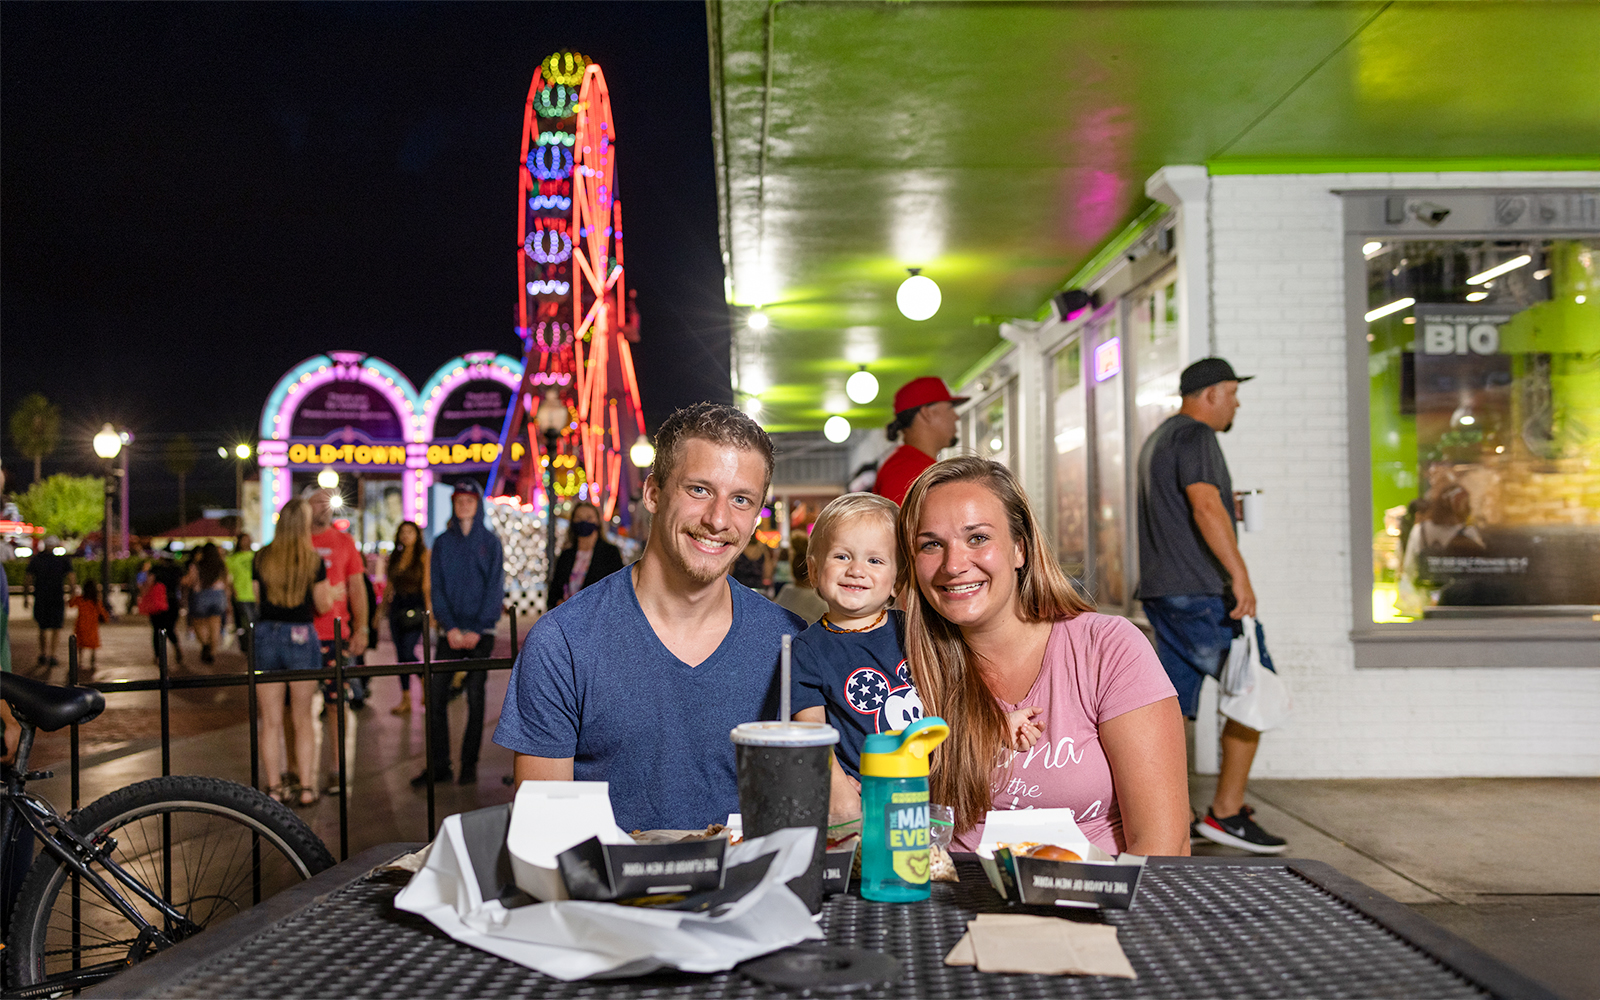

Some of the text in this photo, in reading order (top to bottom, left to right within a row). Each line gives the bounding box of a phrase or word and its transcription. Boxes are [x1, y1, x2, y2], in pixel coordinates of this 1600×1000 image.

[1007, 777, 1042, 798] the
[622, 857, 719, 877] THE FLAVOR OF NEW YORK
[1032, 875, 1129, 894] THE FLAVOR OF NEW YORK
[20, 985, 64, 997] SHIMANO
